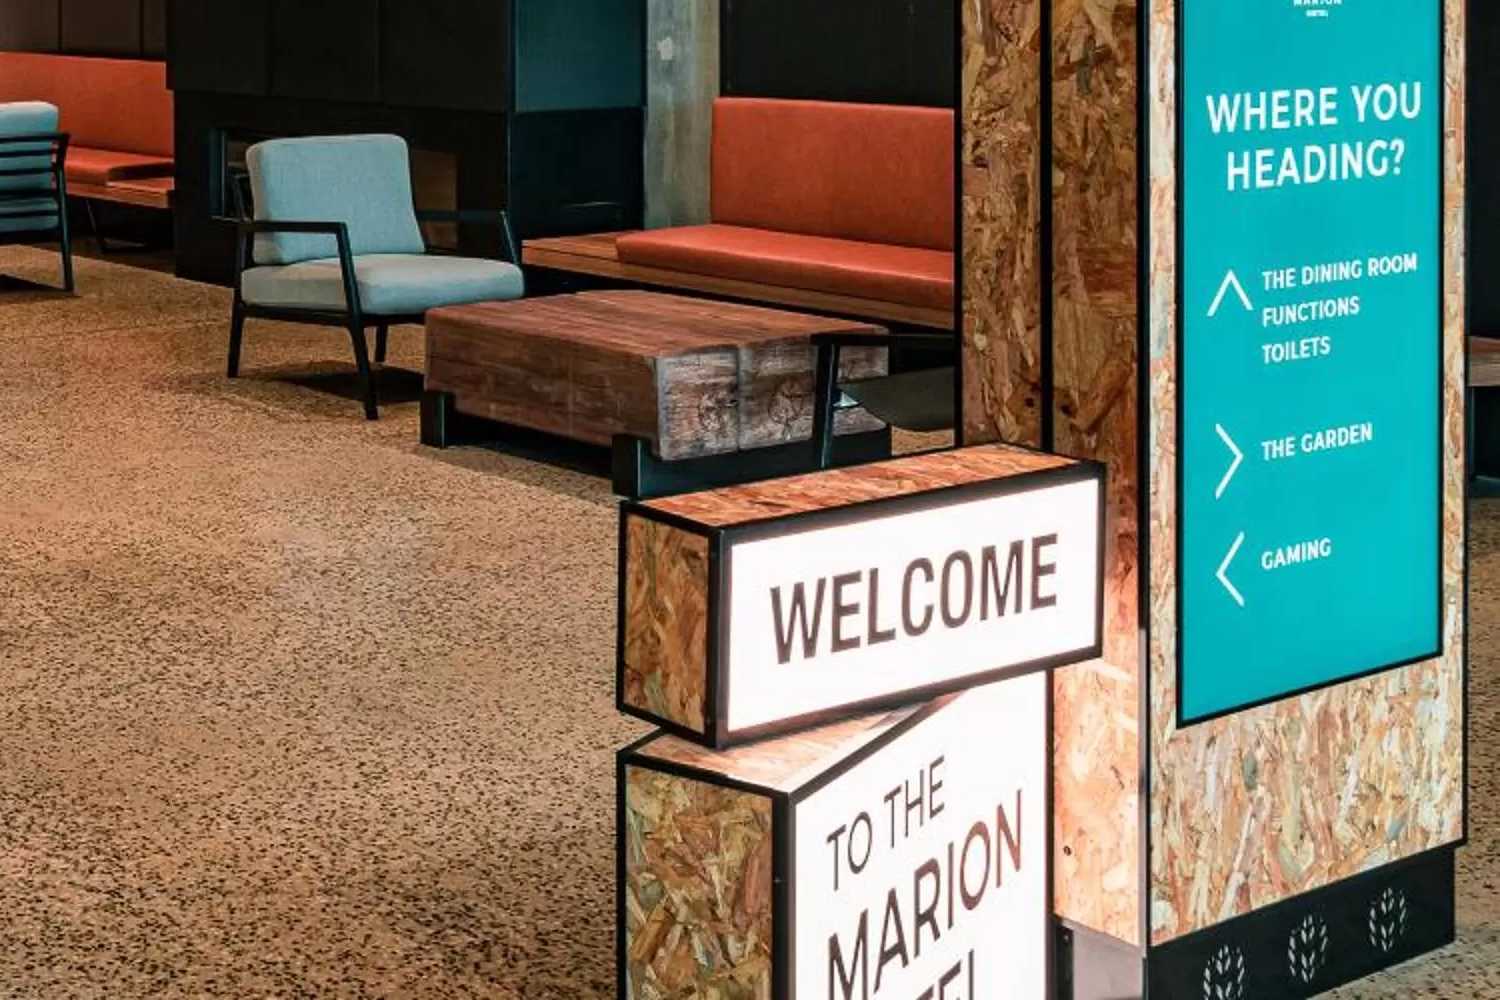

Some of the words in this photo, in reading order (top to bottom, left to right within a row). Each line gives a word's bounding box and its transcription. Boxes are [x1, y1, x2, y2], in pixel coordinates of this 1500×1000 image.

[1206, 87, 1338, 134] WHERE
[1351, 81, 1421, 123] YOU
[1227, 138, 1405, 191] HEADING?
[1262, 267, 1296, 291] THE
[1301, 260, 1362, 285] DINING
[1367, 253, 1417, 277] ROOM
[1262, 295, 1361, 327] FUNCTIONS
[1262, 335, 1331, 364] TOILETS
[1261, 436, 1296, 461] THE
[1301, 422, 1373, 453] GARDEN
[1261, 537, 1332, 570] GAMING
[770, 533, 1058, 665] WELCOME
[826, 811, 873, 892] TO
[884, 755, 945, 848] THE
[828, 789, 1023, 1000] MARION
